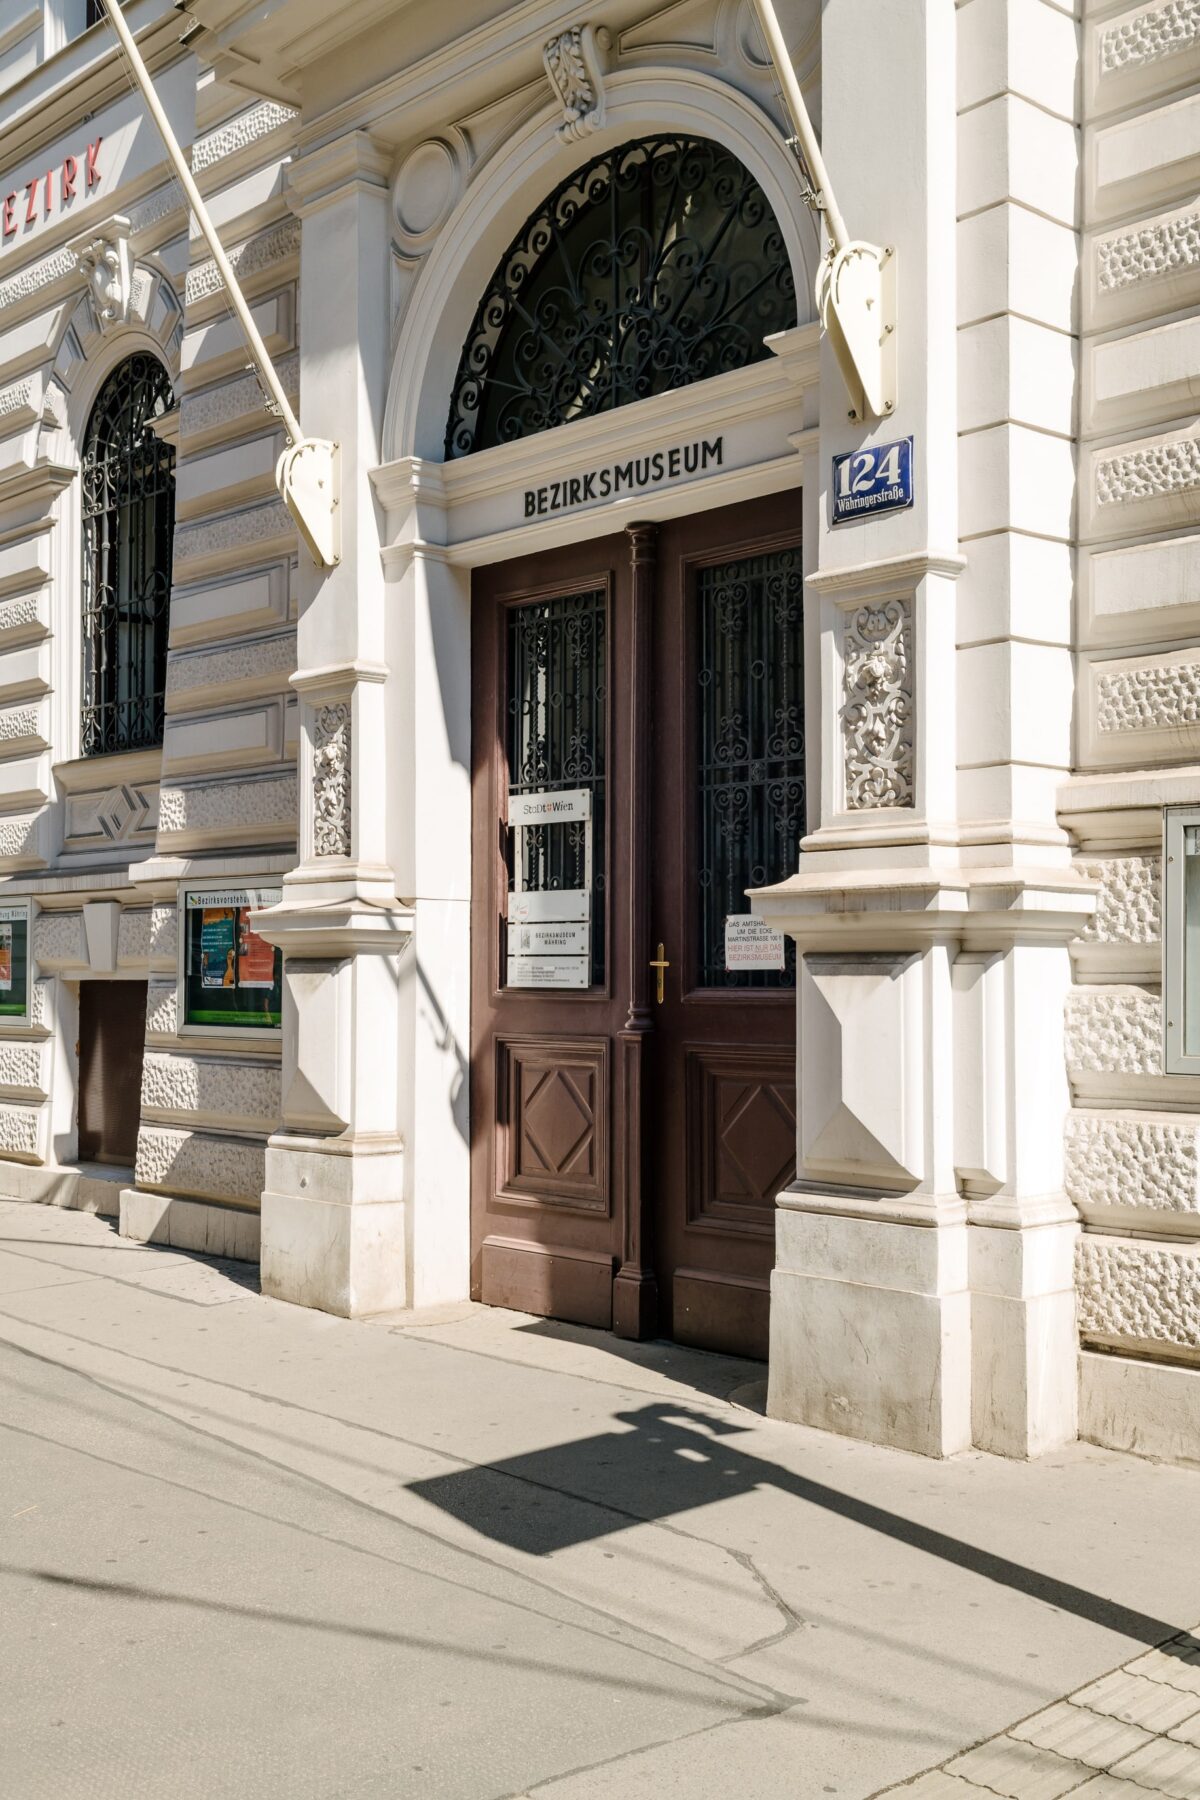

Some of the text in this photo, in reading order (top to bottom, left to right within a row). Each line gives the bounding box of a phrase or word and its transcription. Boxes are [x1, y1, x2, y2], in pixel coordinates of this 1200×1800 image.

[524, 436, 723, 517] BEZIRKSMUSEUM
[838, 445, 901, 497] 124
[837, 485, 904, 512] Währingerstraße
[552, 801, 574, 812] Wien
[728, 944, 742, 952] HIER
[743, 944, 753, 952] IST
[770, 943, 782, 951] DAS
[728, 952, 782, 961] BEZIRKSMUSEUM
